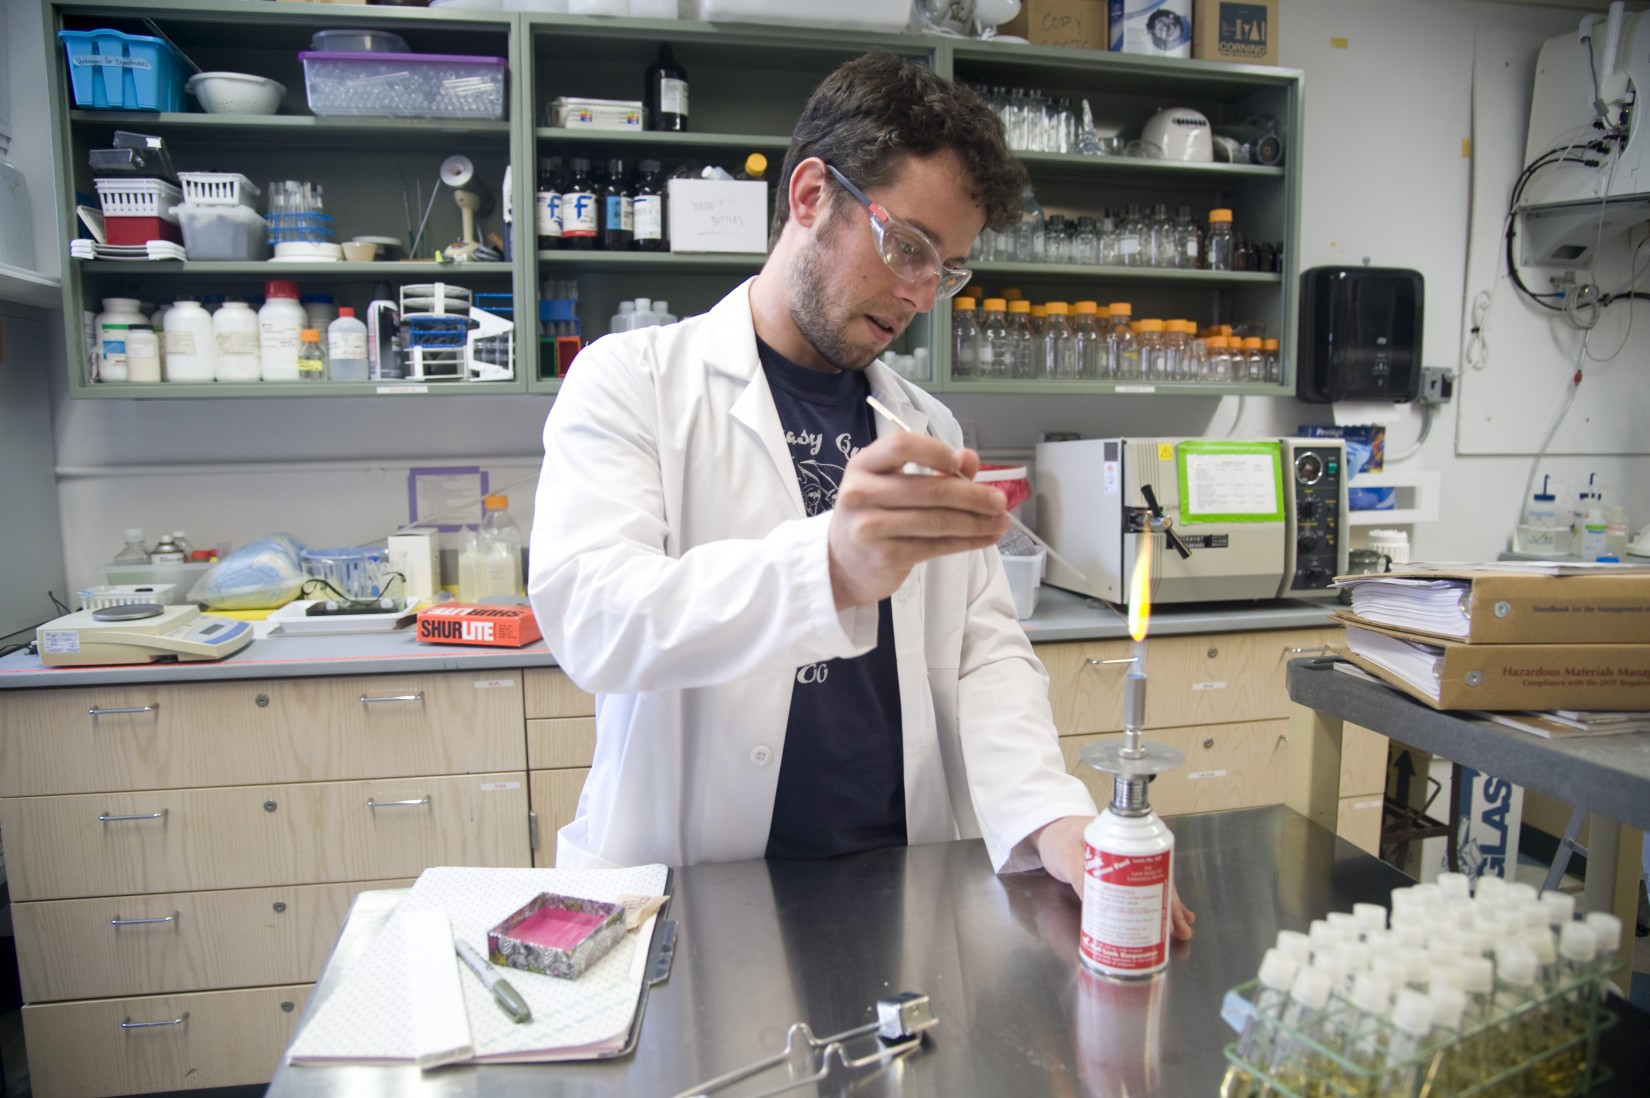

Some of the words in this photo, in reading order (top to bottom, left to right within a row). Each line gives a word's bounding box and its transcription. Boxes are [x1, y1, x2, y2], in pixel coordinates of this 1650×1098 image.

[1219, 41, 1266, 55] CORNING
[1532, 605, 1569, 613] Handbook
[1583, 605, 1596, 613] the
[1598, 605, 1643, 615] Management
[421, 620, 494, 641] SHURLITE
[1502, 667, 1561, 677] Hazardous
[1563, 667, 1614, 677] Materials
[1617, 667, 1650, 679] Manag
[1522, 680, 1566, 688] Compliance
[1477, 776, 1512, 879] GLAS
